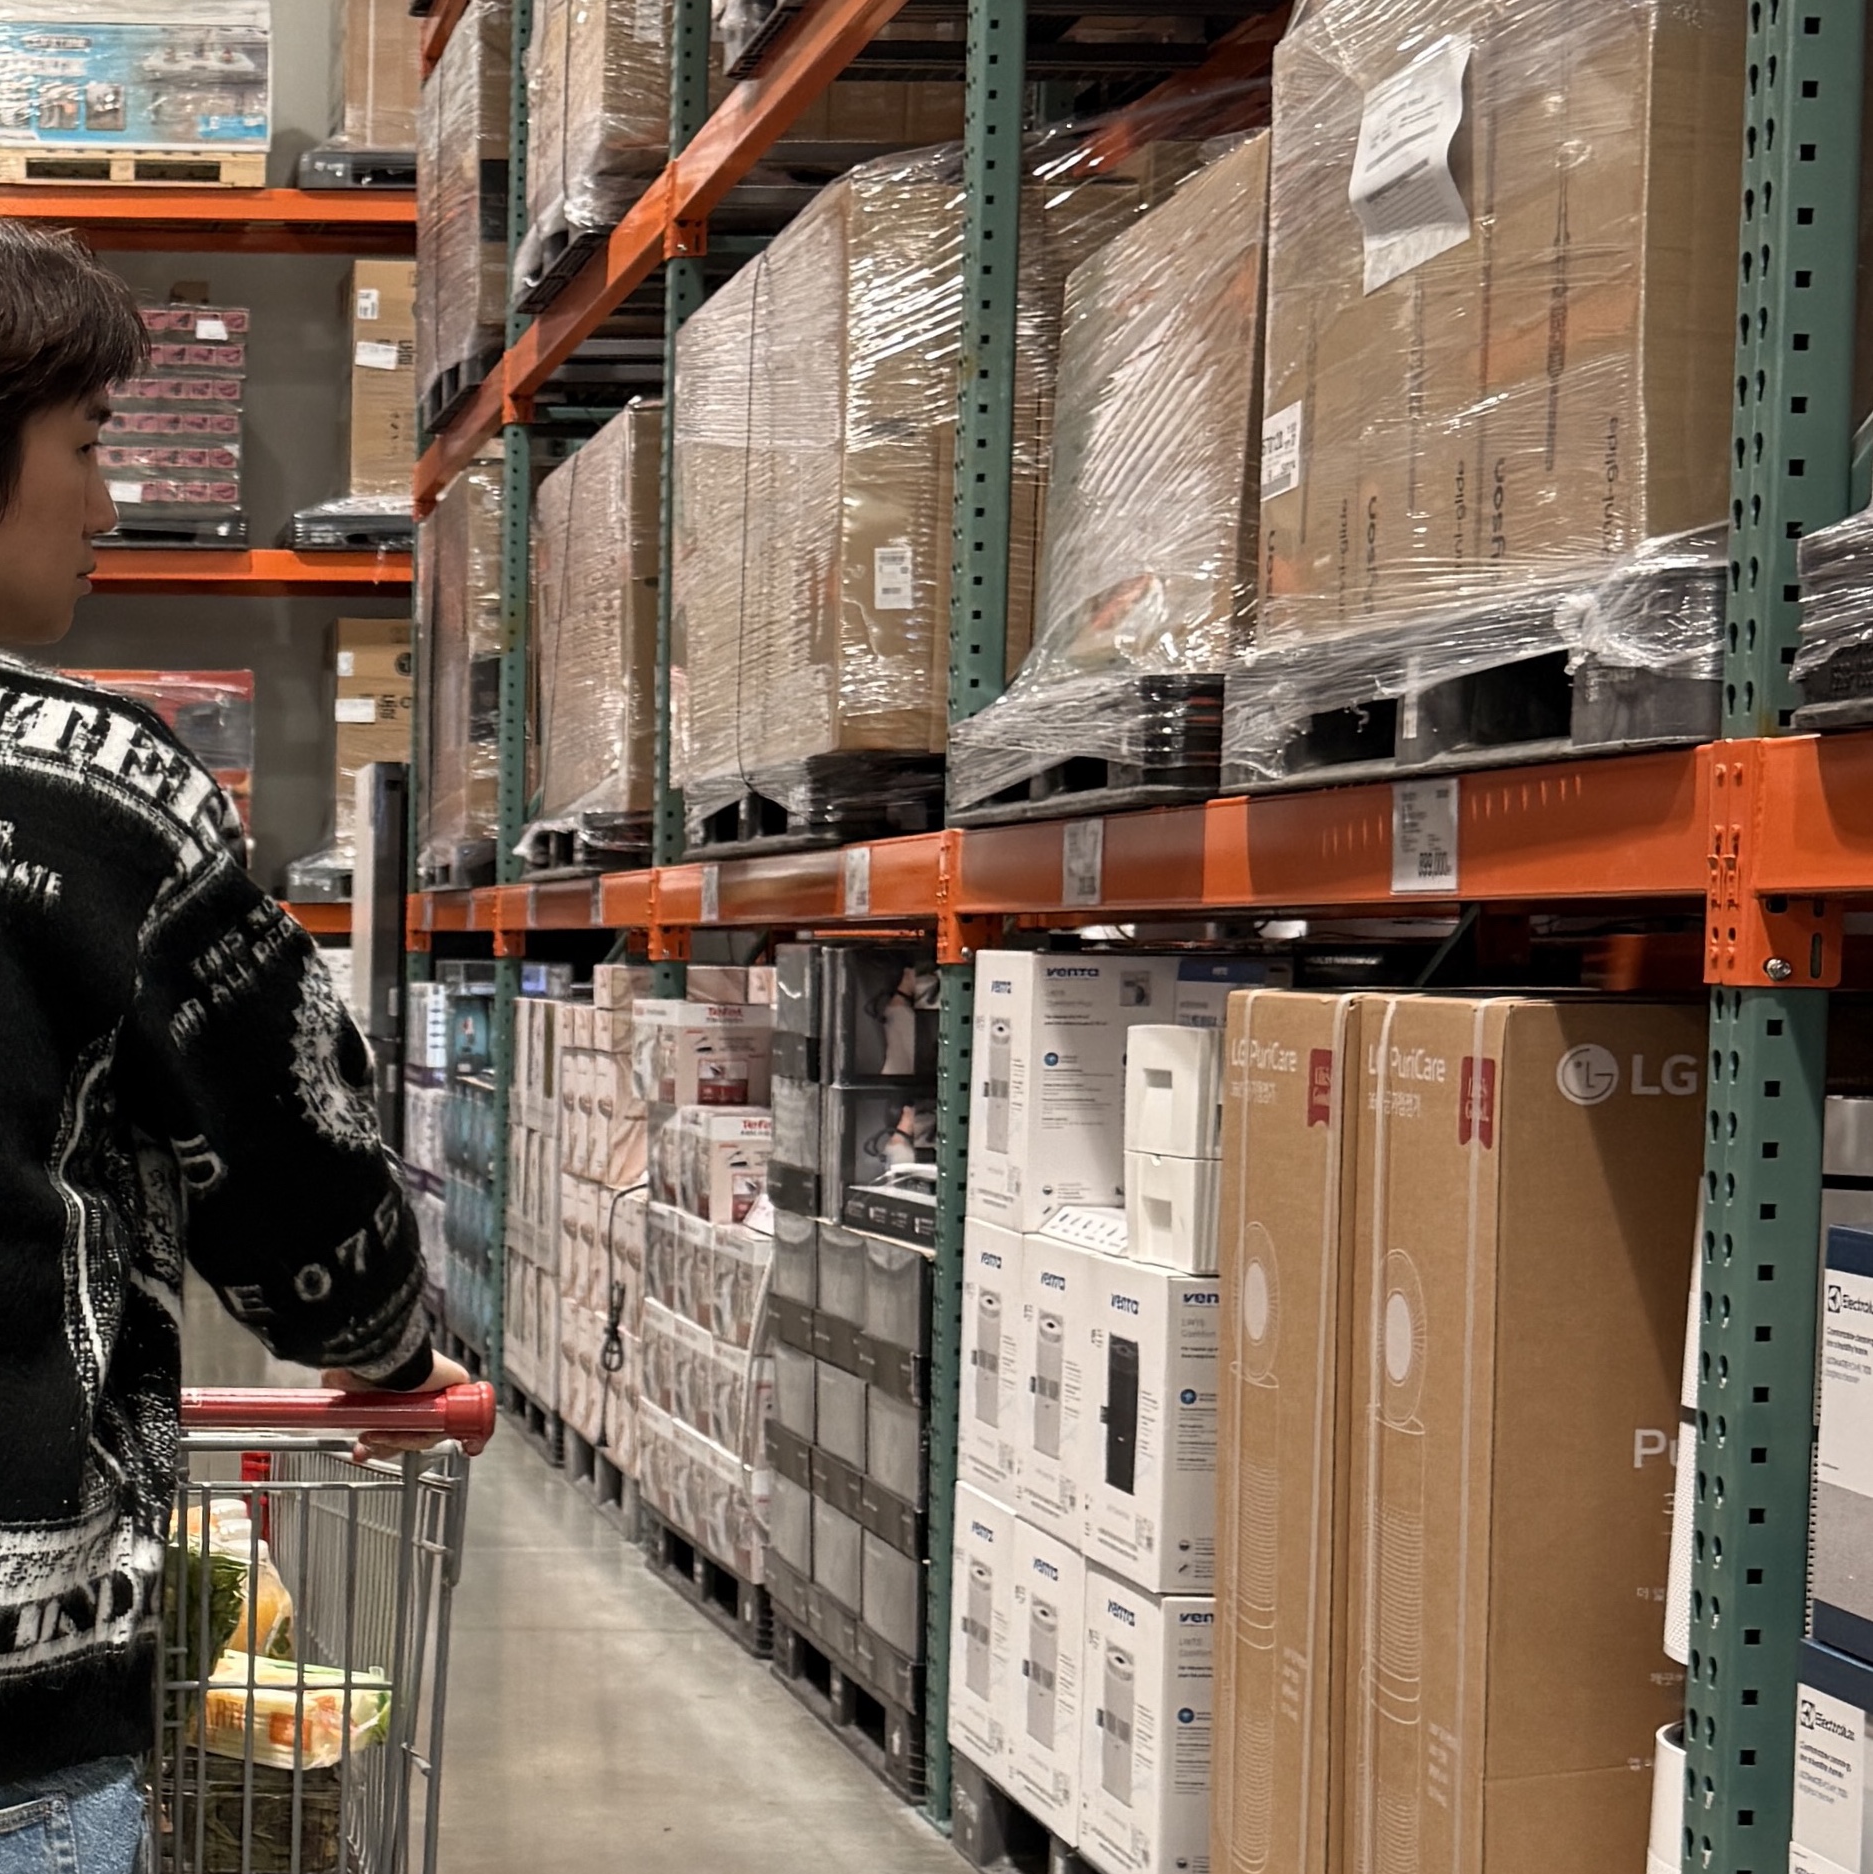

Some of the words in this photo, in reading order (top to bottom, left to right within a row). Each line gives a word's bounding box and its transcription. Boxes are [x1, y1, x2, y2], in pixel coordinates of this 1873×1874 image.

[1046, 968, 1099, 977] venta
[1250, 1040, 1297, 1072] PuriCare
[1391, 1046, 1446, 1082] PuriCare
[1631, 1054, 1697, 1095] LG
